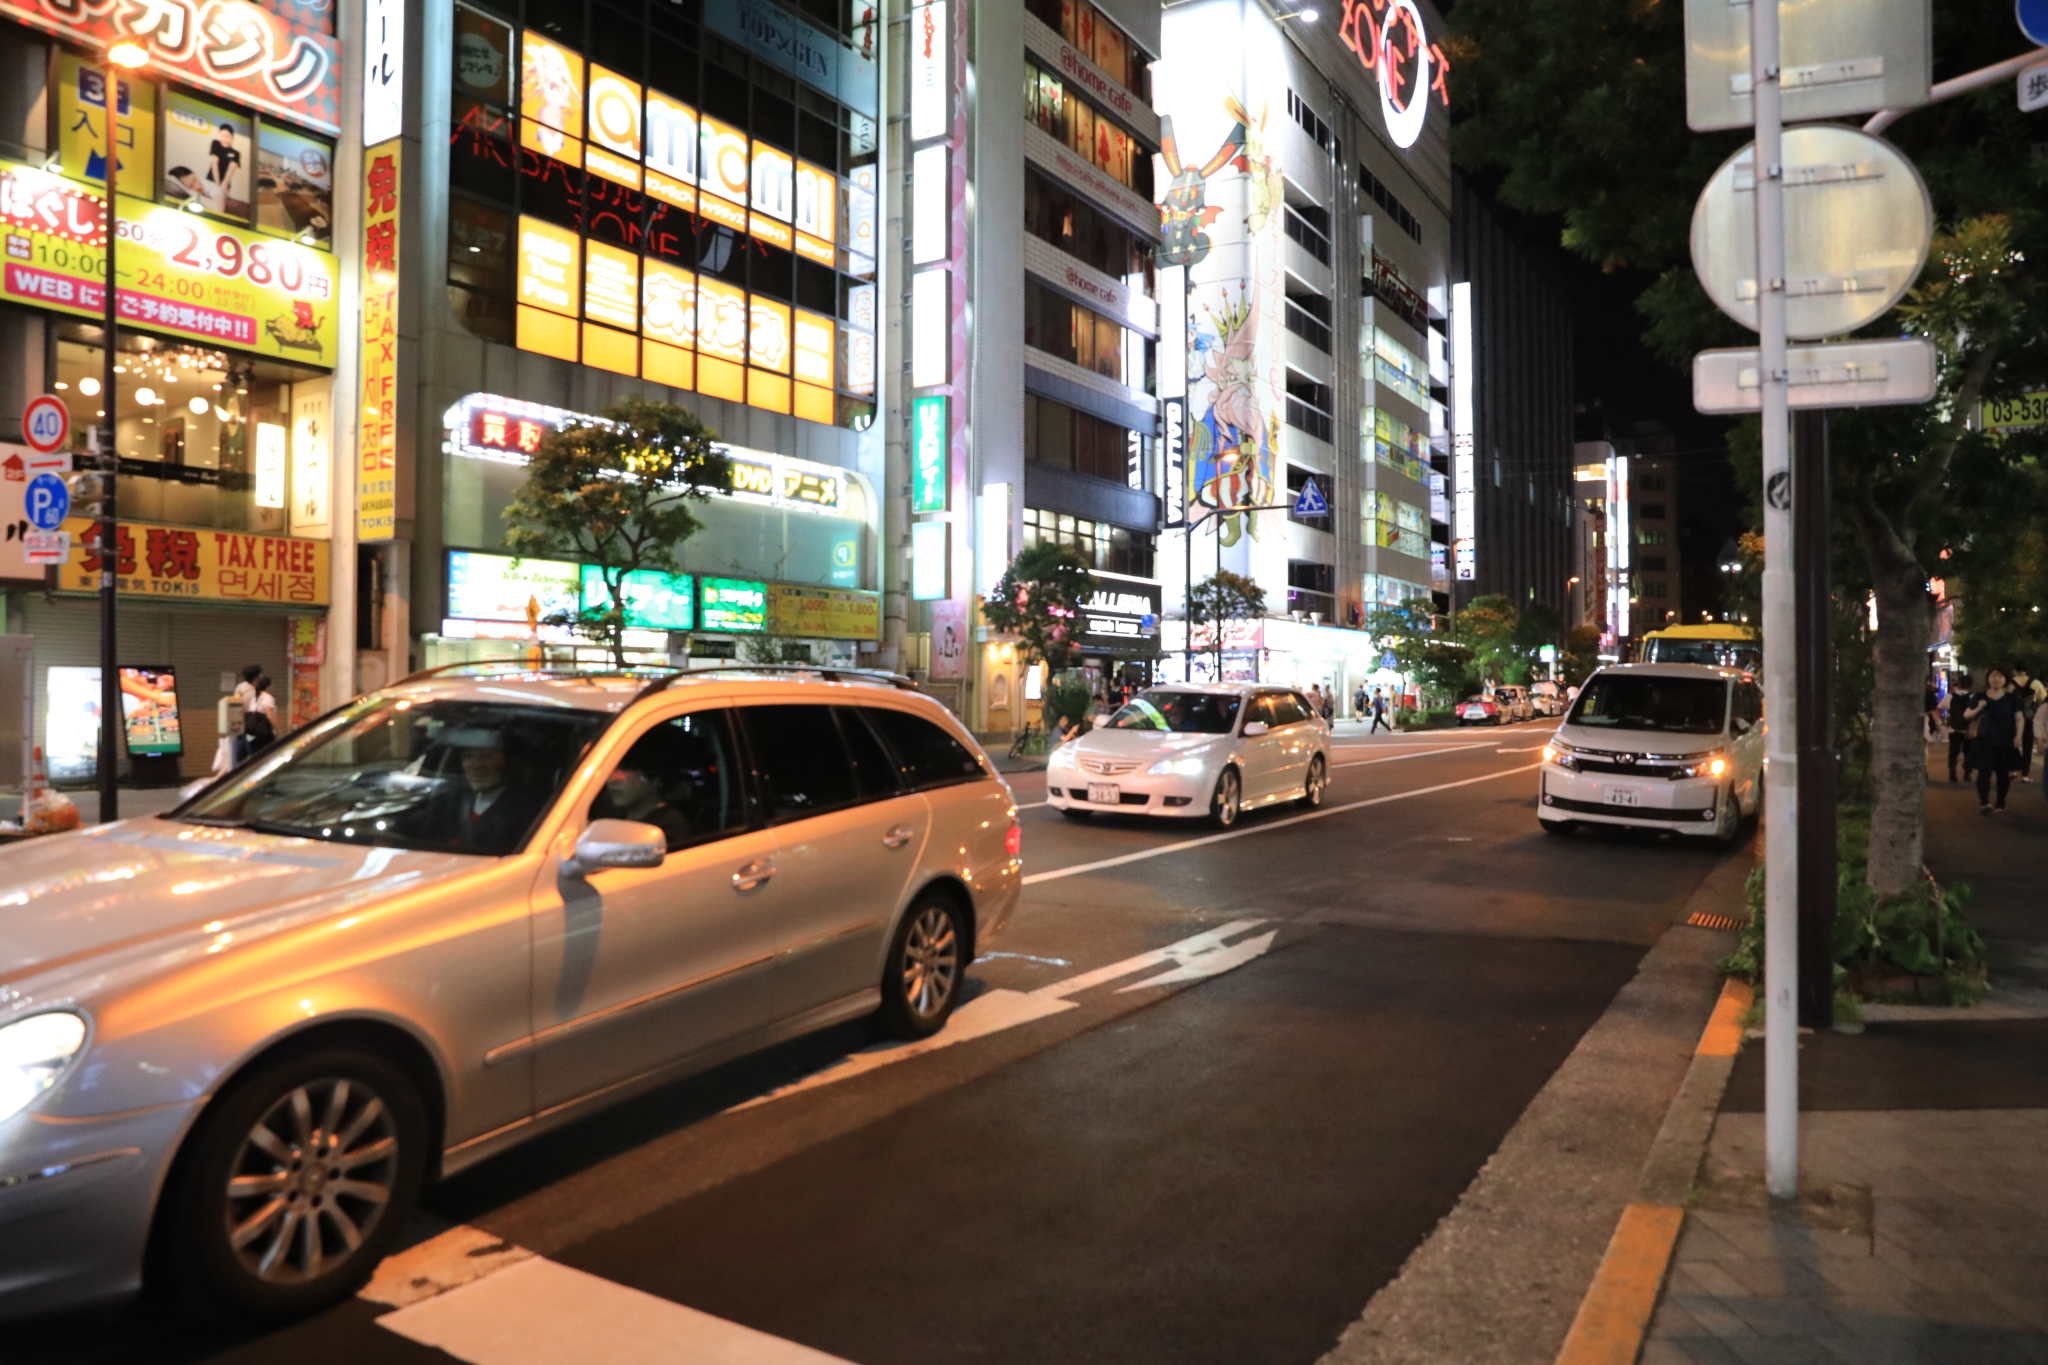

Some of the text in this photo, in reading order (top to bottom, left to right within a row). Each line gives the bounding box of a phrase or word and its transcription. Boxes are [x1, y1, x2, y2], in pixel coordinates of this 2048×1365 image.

[1061, 45, 1132, 117] @home cafe
[366, 155, 397, 283] 免税
[14, 270, 74, 301] WEB
[34, 412, 58, 436] 40
[734, 463, 773, 493] DVD
[784, 469, 836, 504] アニメ
[33, 488, 52, 524] P
[79, 522, 201, 580] 免税
[214, 533, 316, 574] TAX FREE
[217, 569, 316, 601] 면세점
